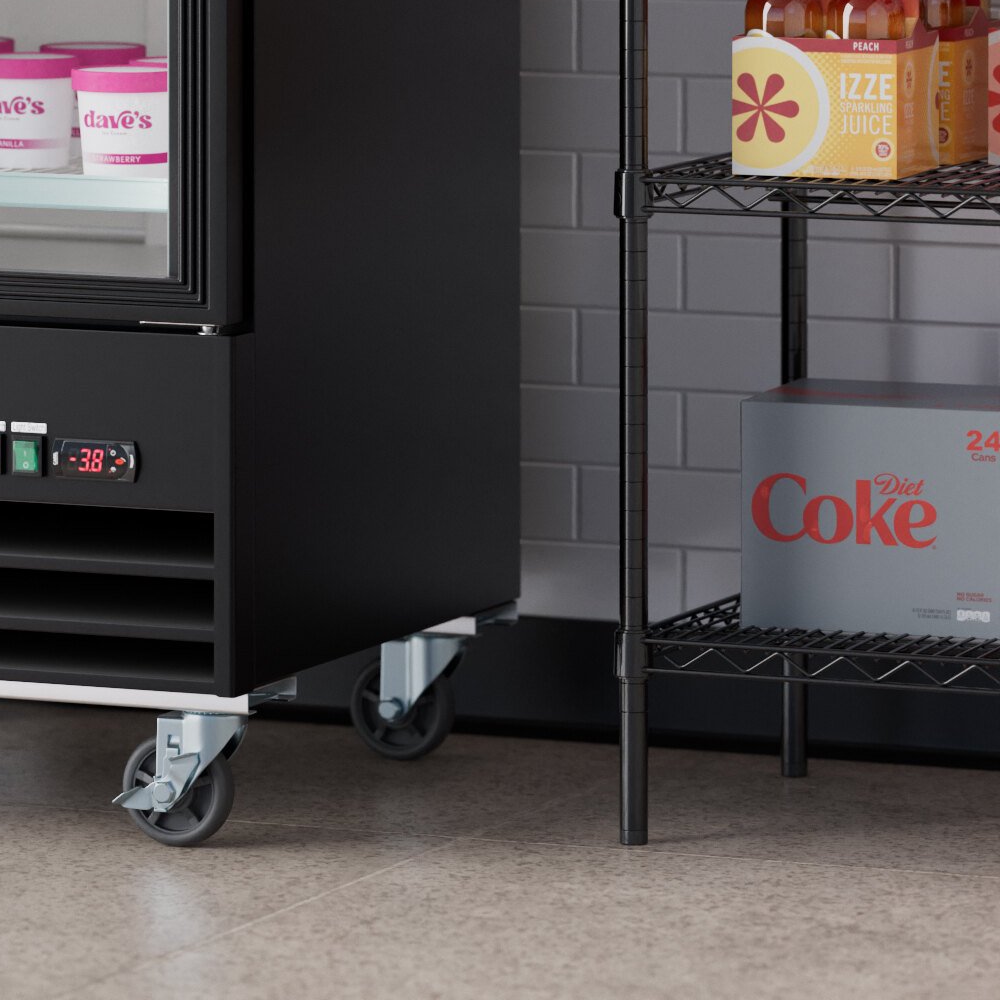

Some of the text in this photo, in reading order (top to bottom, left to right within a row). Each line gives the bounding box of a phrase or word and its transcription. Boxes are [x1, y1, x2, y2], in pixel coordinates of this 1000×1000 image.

[852, 41, 880, 52] PEACH
[840, 72, 894, 101] IZZE
[840, 101, 893, 113] SPARKLING
[83, 110, 153, 129] dave's
[840, 113, 893, 136] JUICE
[966, 430, 1000, 452] 24
[971, 453, 996, 462] Cans
[874, 472, 925, 495] Diet
[751, 472, 937, 549] Coke
